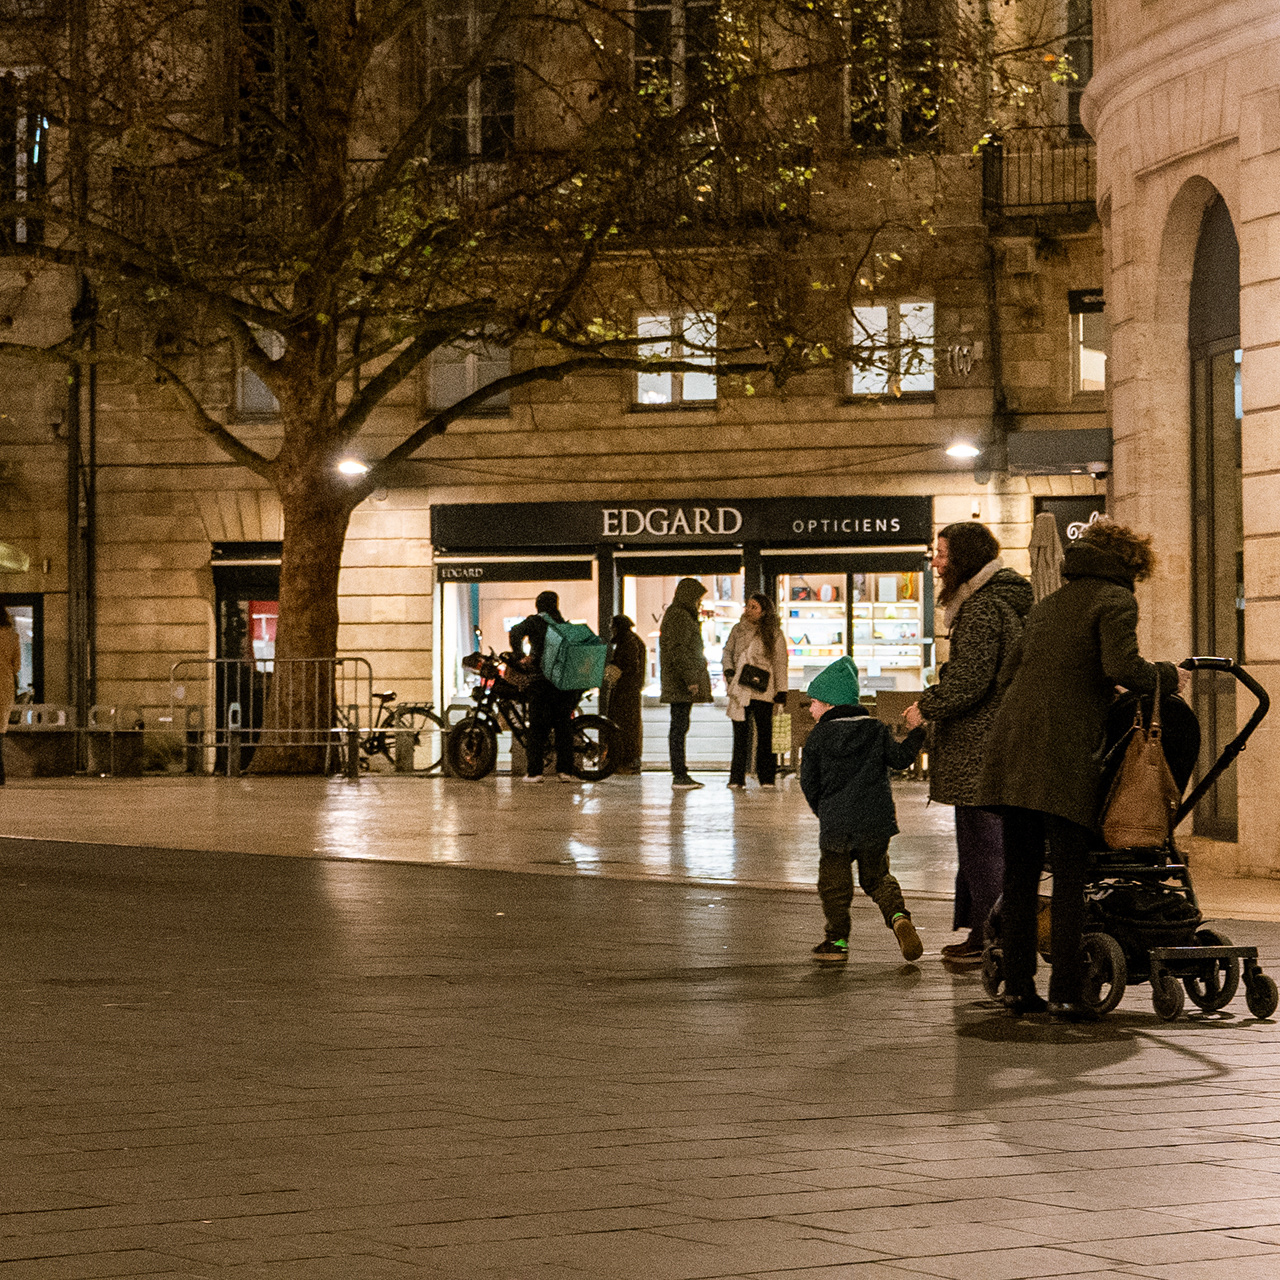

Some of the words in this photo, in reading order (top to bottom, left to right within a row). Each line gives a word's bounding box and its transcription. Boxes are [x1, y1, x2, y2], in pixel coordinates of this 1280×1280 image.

[602, 507, 743, 536] EDGARD
[792, 518, 901, 533] OPTICIENS
[441, 568, 484, 578] EDGARD
